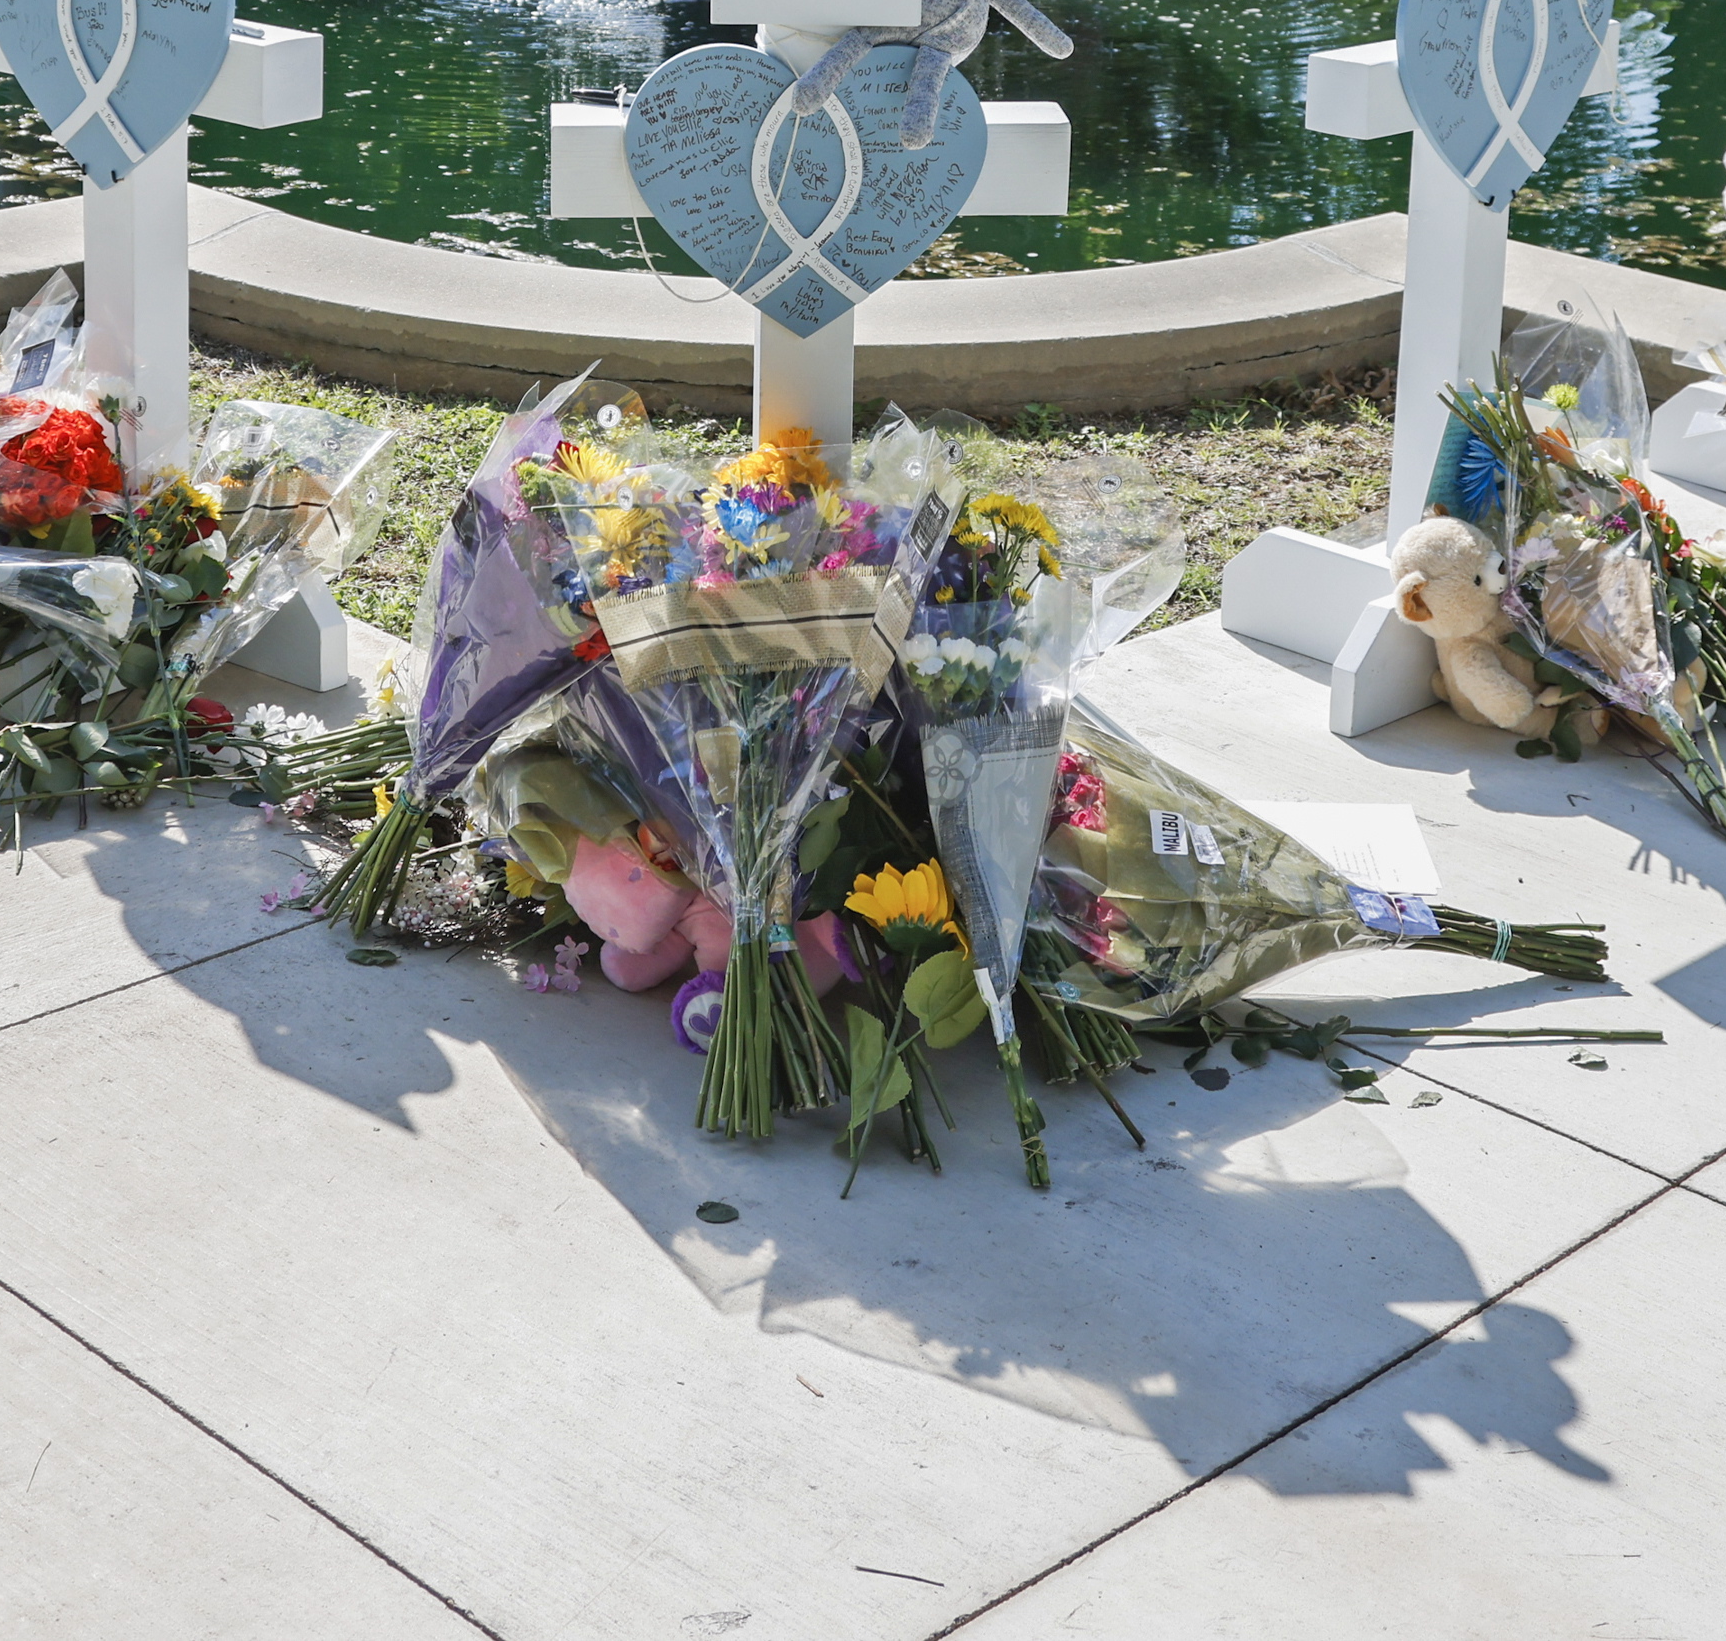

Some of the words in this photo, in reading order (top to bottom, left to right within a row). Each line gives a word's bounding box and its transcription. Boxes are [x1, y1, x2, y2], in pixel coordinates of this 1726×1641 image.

[851, 67, 871, 78] YOU
[721, 163, 747, 177] USA
[871, 230, 894, 247] Easy
[1162, 812, 1181, 852] MALIBU
